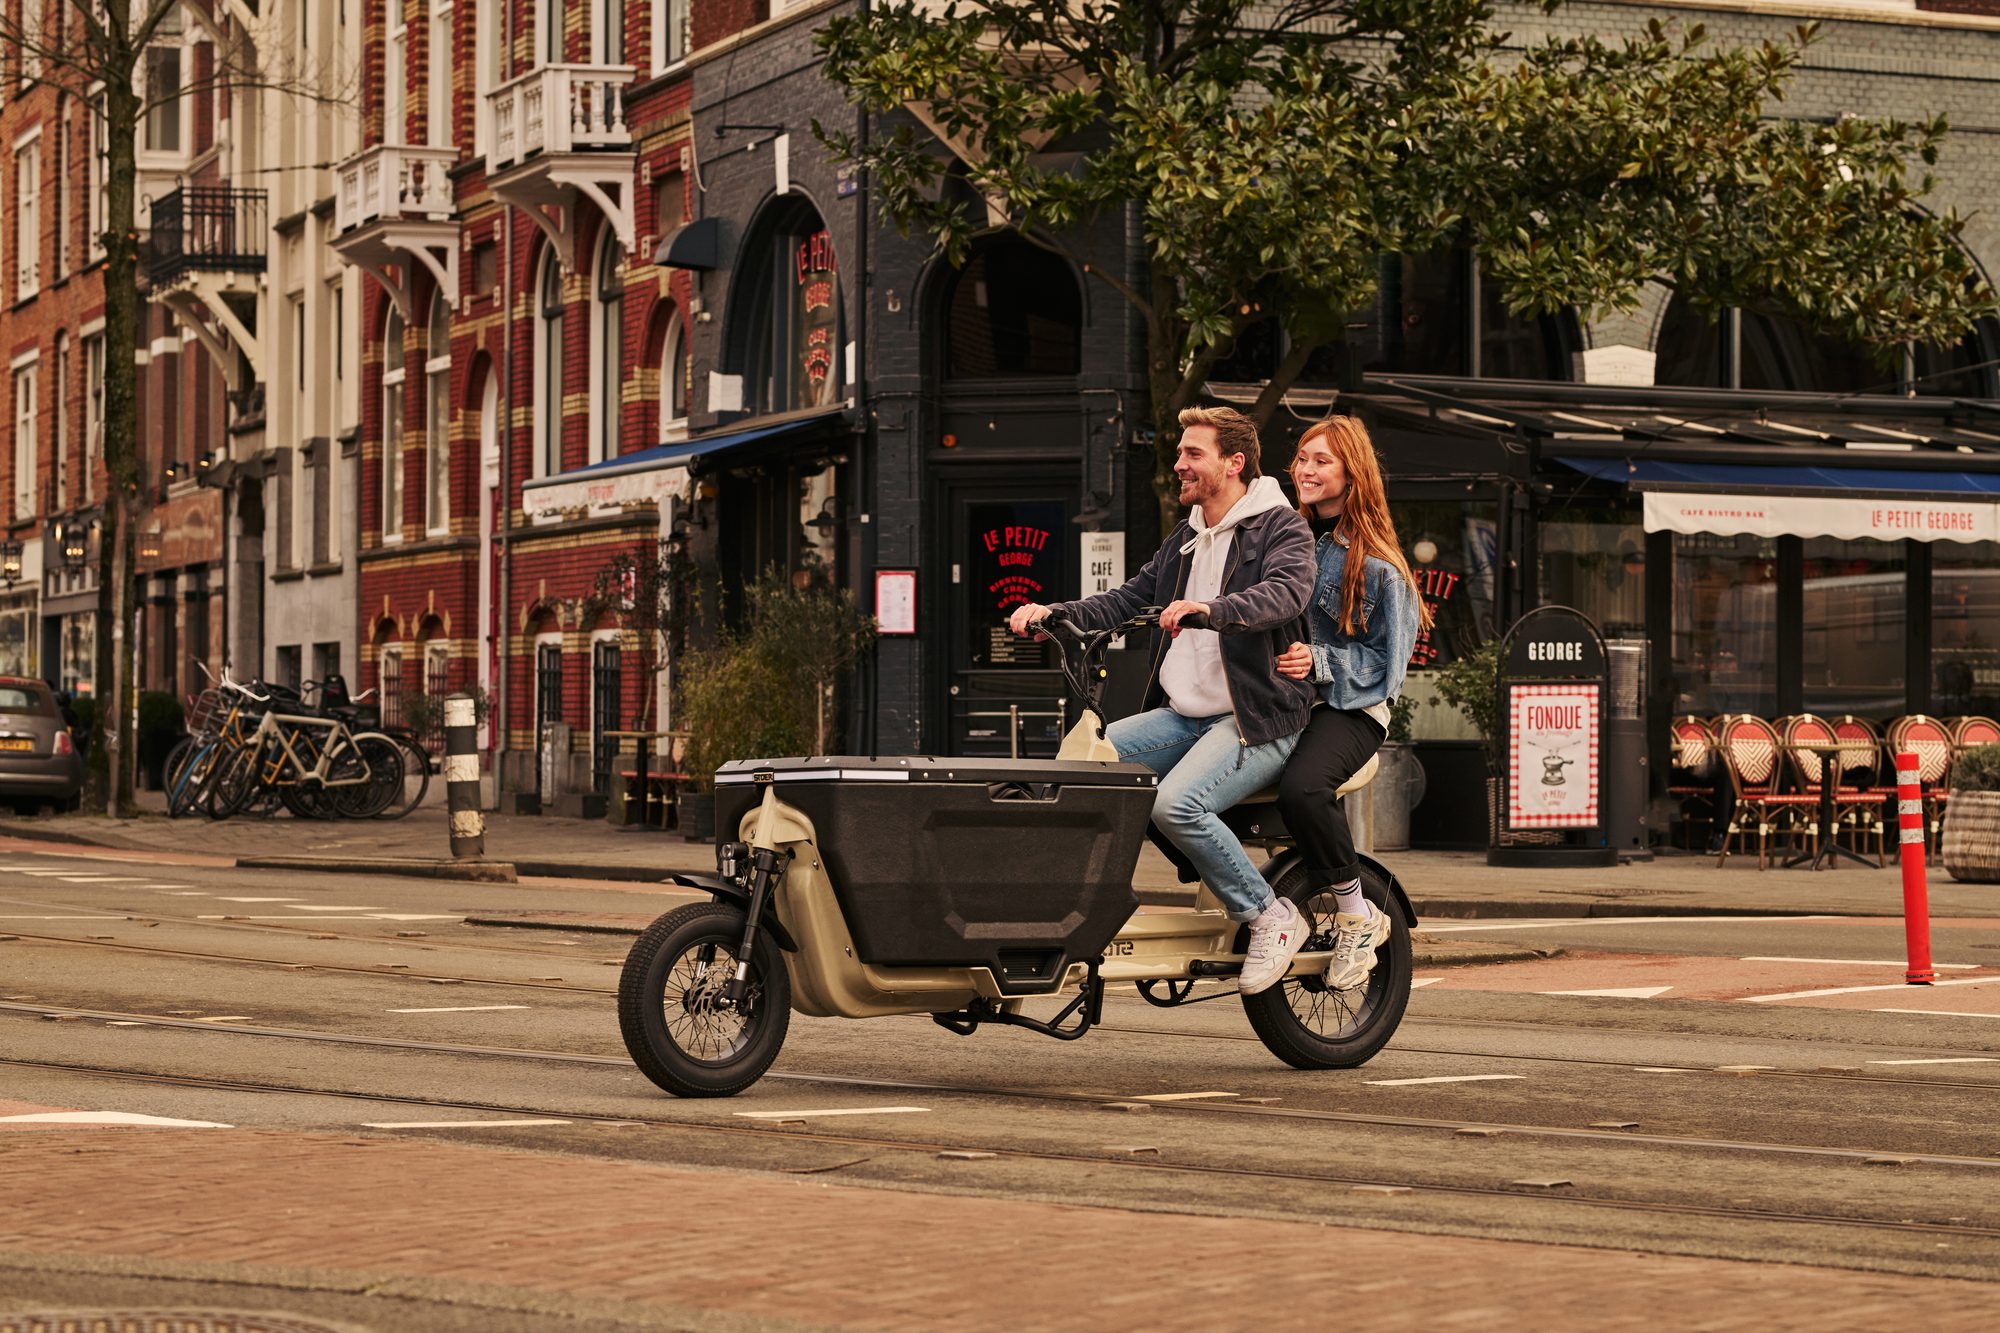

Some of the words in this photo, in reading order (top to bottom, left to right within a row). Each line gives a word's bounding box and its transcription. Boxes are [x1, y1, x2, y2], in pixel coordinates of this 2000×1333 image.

[1708, 509, 1742, 517] BISTRO
[1872, 510, 1882, 528] LE
[1888, 510, 1922, 528] PETIT
[1927, 511, 1974, 530] GEORGE
[983, 529, 999, 552] LE
[1005, 526, 1050, 551] PETIT
[998, 552, 1033, 567] GEORGE
[1091, 558, 1112, 576] CAFÉ
[989, 576, 1043, 592] BIENVENUE
[1003, 585, 1029, 594] CHEZ
[1096, 578, 1108, 592] AU
[1413, 568, 1460, 600] ETIT
[998, 595, 1031, 609] GEORG
[1528, 641, 1583, 661] GEORGE
[1527, 706, 1582, 730] FONDUE
